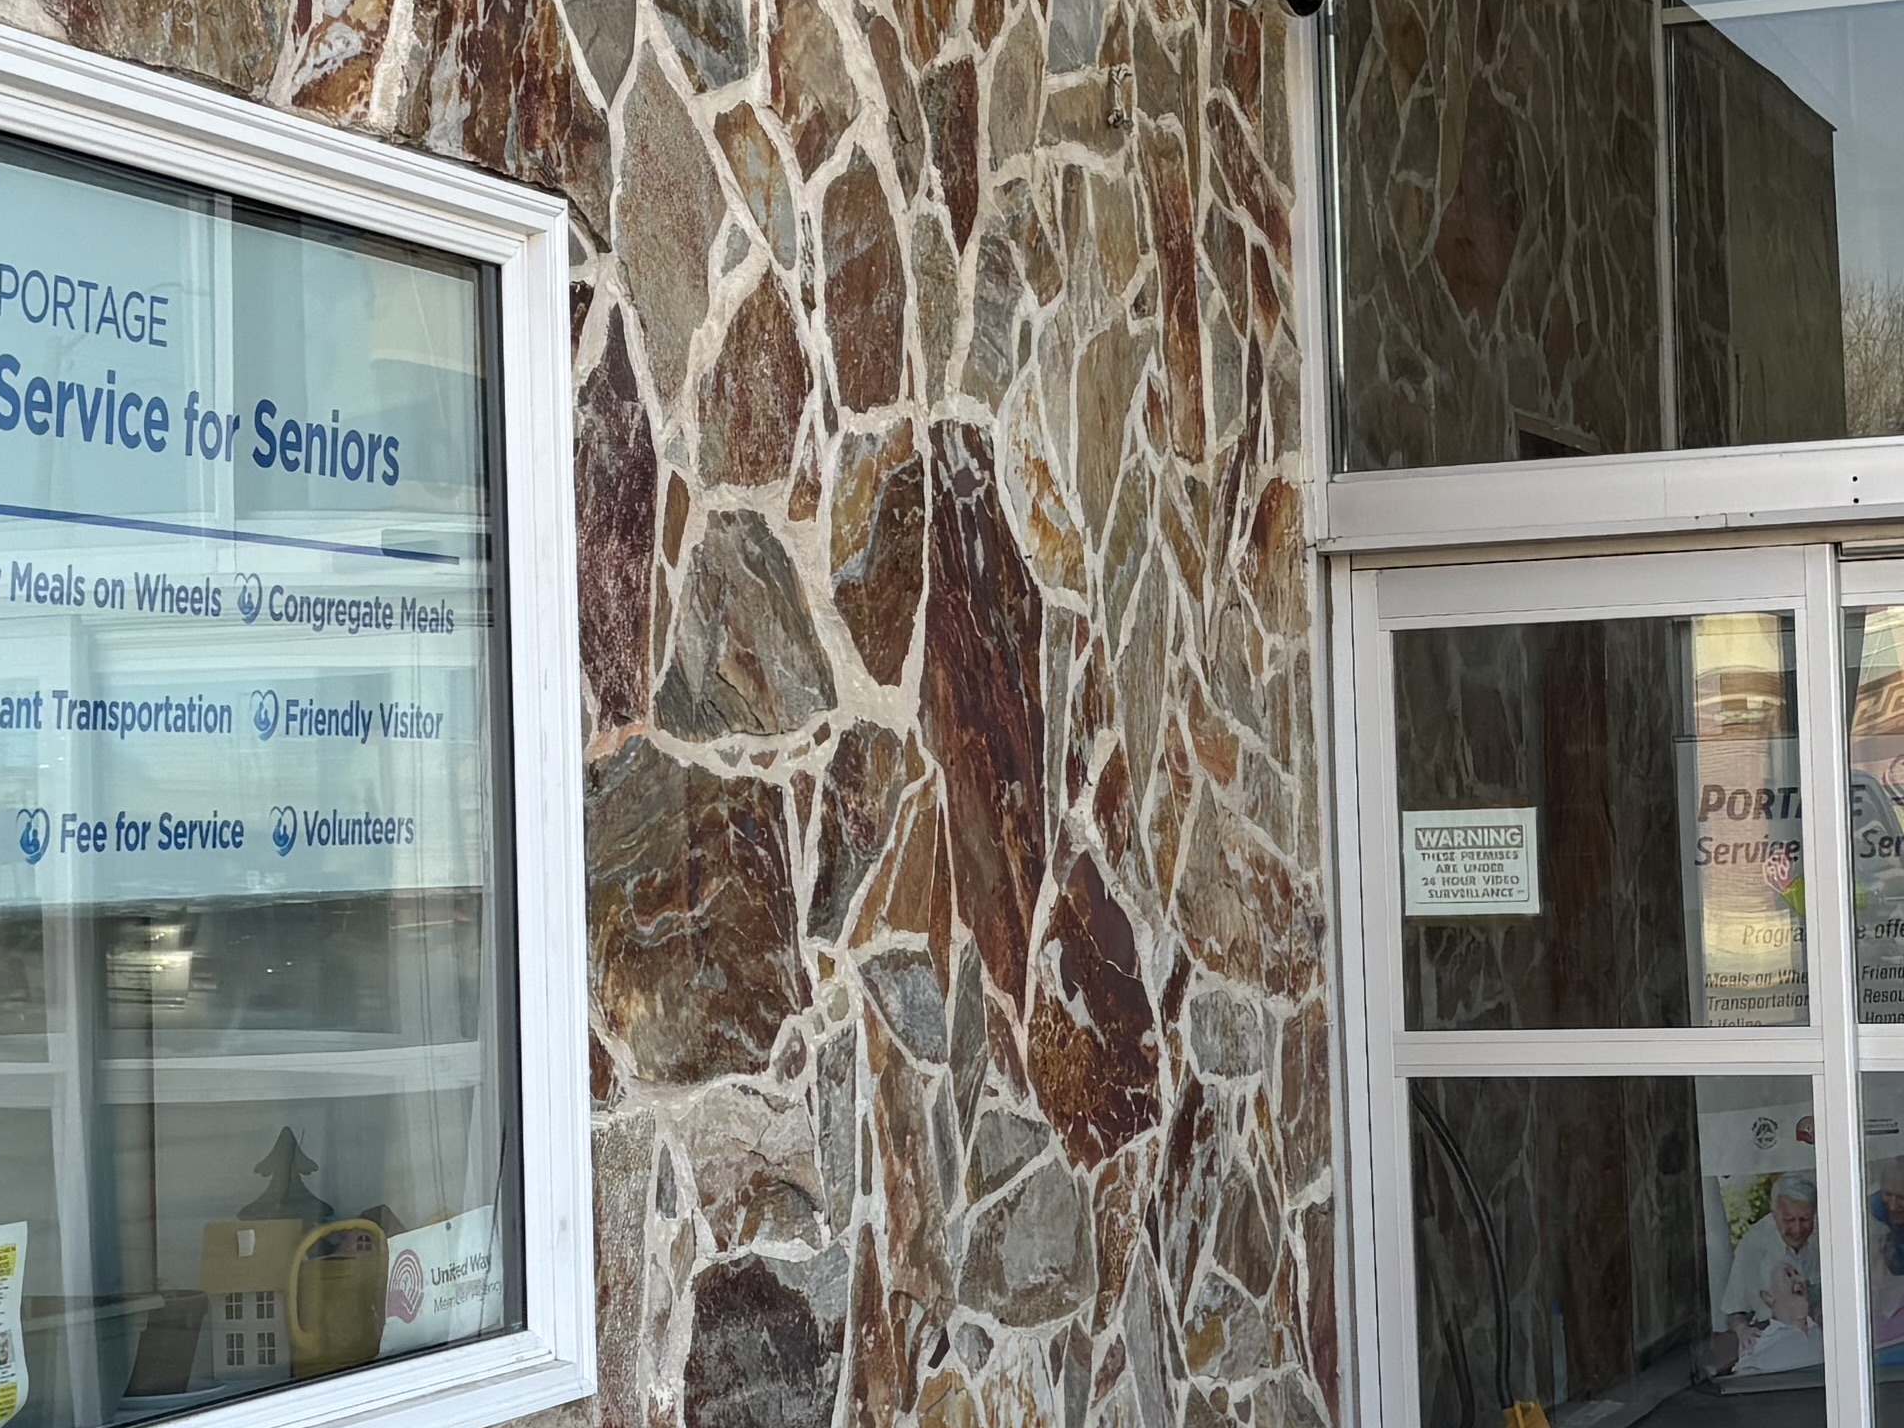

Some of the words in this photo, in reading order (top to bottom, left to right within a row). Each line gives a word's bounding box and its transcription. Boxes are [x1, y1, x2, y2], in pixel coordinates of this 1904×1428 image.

[184, 390, 240, 462] for
[252, 398, 400, 486] Seniors
[9, 560, 86, 607] Meals
[93, 577, 125, 610] on
[134, 572, 223, 617] Wheels
[268, 584, 394, 635] Congregate
[399, 595, 456, 635] Meals
[52, 689, 232, 740] Transportation
[284, 698, 373, 744] Friendly
[379, 701, 444, 740] Visitor
[1698, 784, 1866, 822] PORTE
[60, 813, 107, 854] Fee
[115, 811, 152, 853] for
[158, 810, 245, 850] Service
[302, 810, 415, 847] Volunteers
[1416, 827, 1523, 848] WARNING
[1695, 834, 1801, 866] Service
[1421, 877, 1437, 887] 24
[1442, 876, 1476, 887] HOUR
[1482, 875, 1520, 885] VIDEO
[1742, 925, 1807, 948] Progra
[1705, 973, 1749, 988] Meals
[1756, 972, 1772, 987] on
[1779, 969, 1808, 985] Whe
[431, 1257, 468, 1286] United
[470, 1252, 492, 1275] Way
